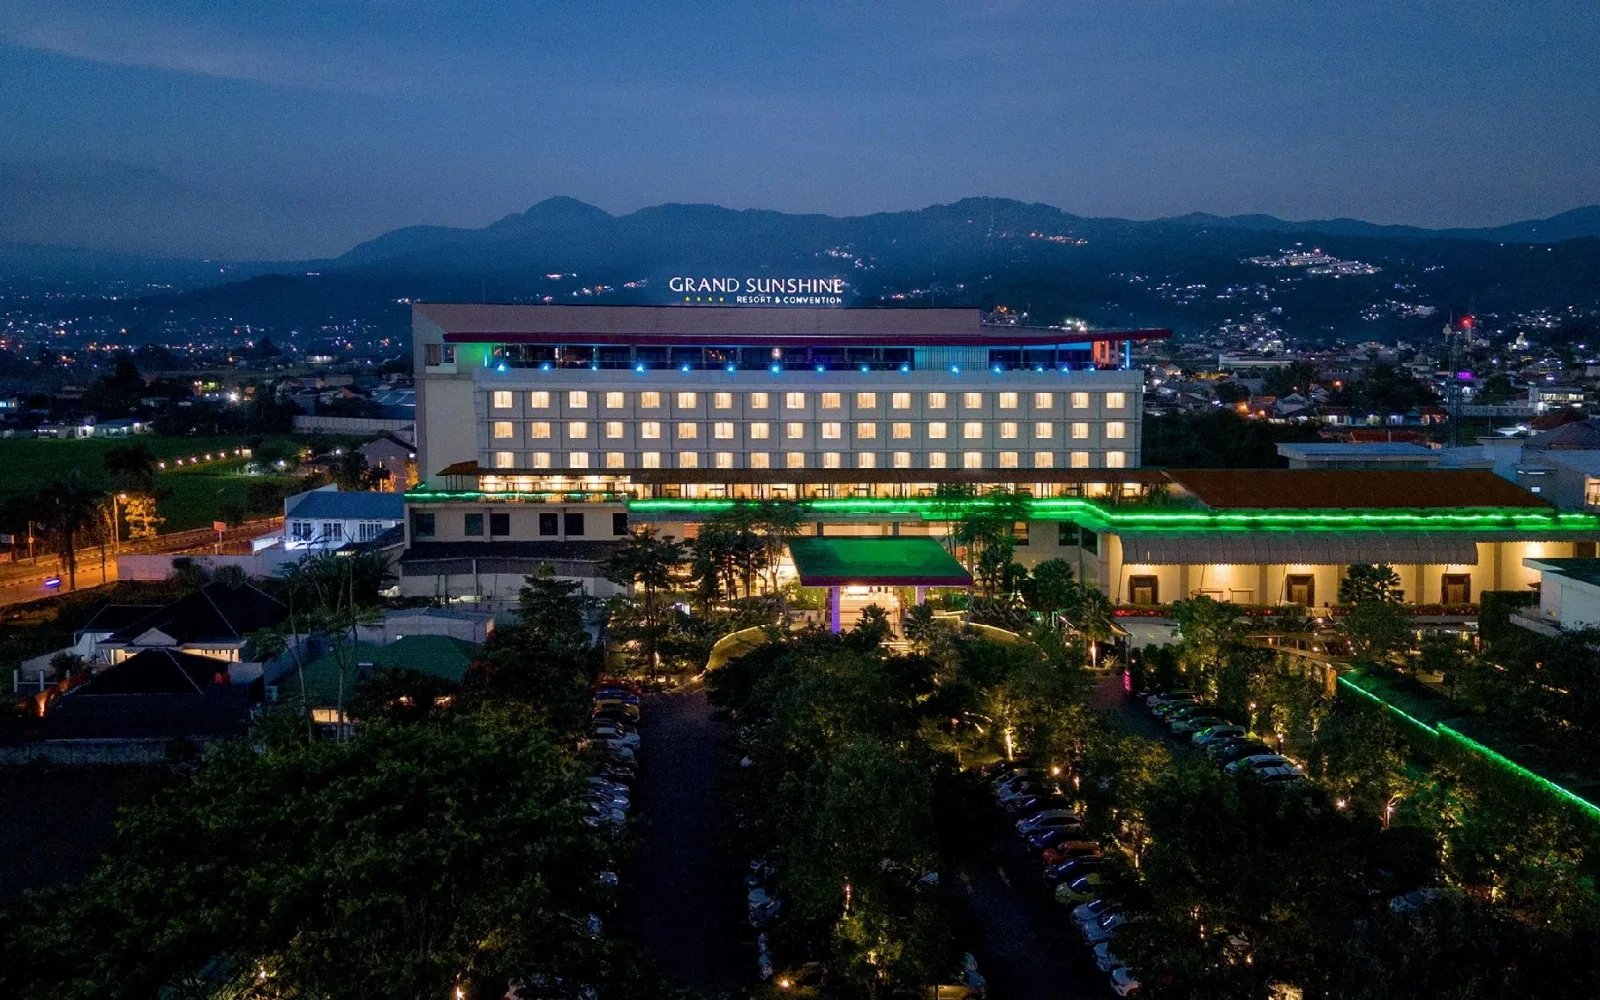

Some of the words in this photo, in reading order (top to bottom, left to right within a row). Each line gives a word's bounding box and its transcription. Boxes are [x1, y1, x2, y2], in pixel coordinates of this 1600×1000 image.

[669, 276, 740, 292] GRAND
[746, 278, 843, 293] SUNSHINE
[737, 296, 771, 304] RESORT
[775, 296, 781, 304] &
[783, 296, 842, 304] CONVENTION
